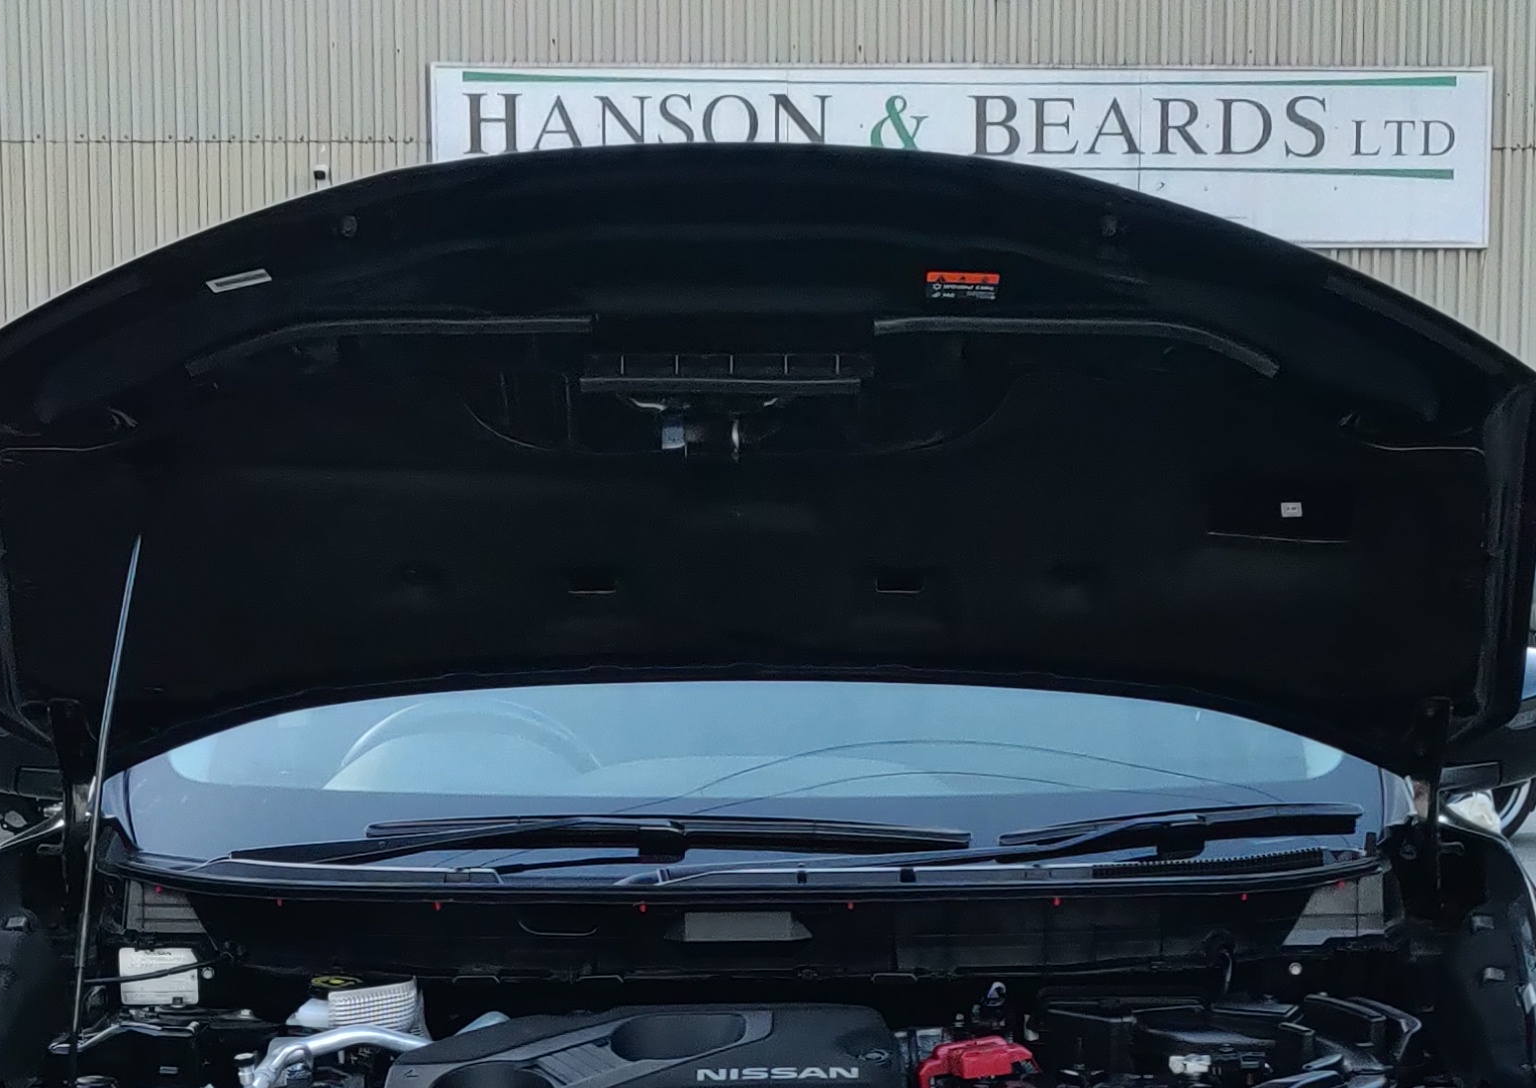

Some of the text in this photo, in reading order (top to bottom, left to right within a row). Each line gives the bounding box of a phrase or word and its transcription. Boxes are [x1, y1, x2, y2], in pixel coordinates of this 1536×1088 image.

[462, 91, 1457, 158] HANSON & BEARDS LTD
[696, 1066, 860, 1082] NISSAN
